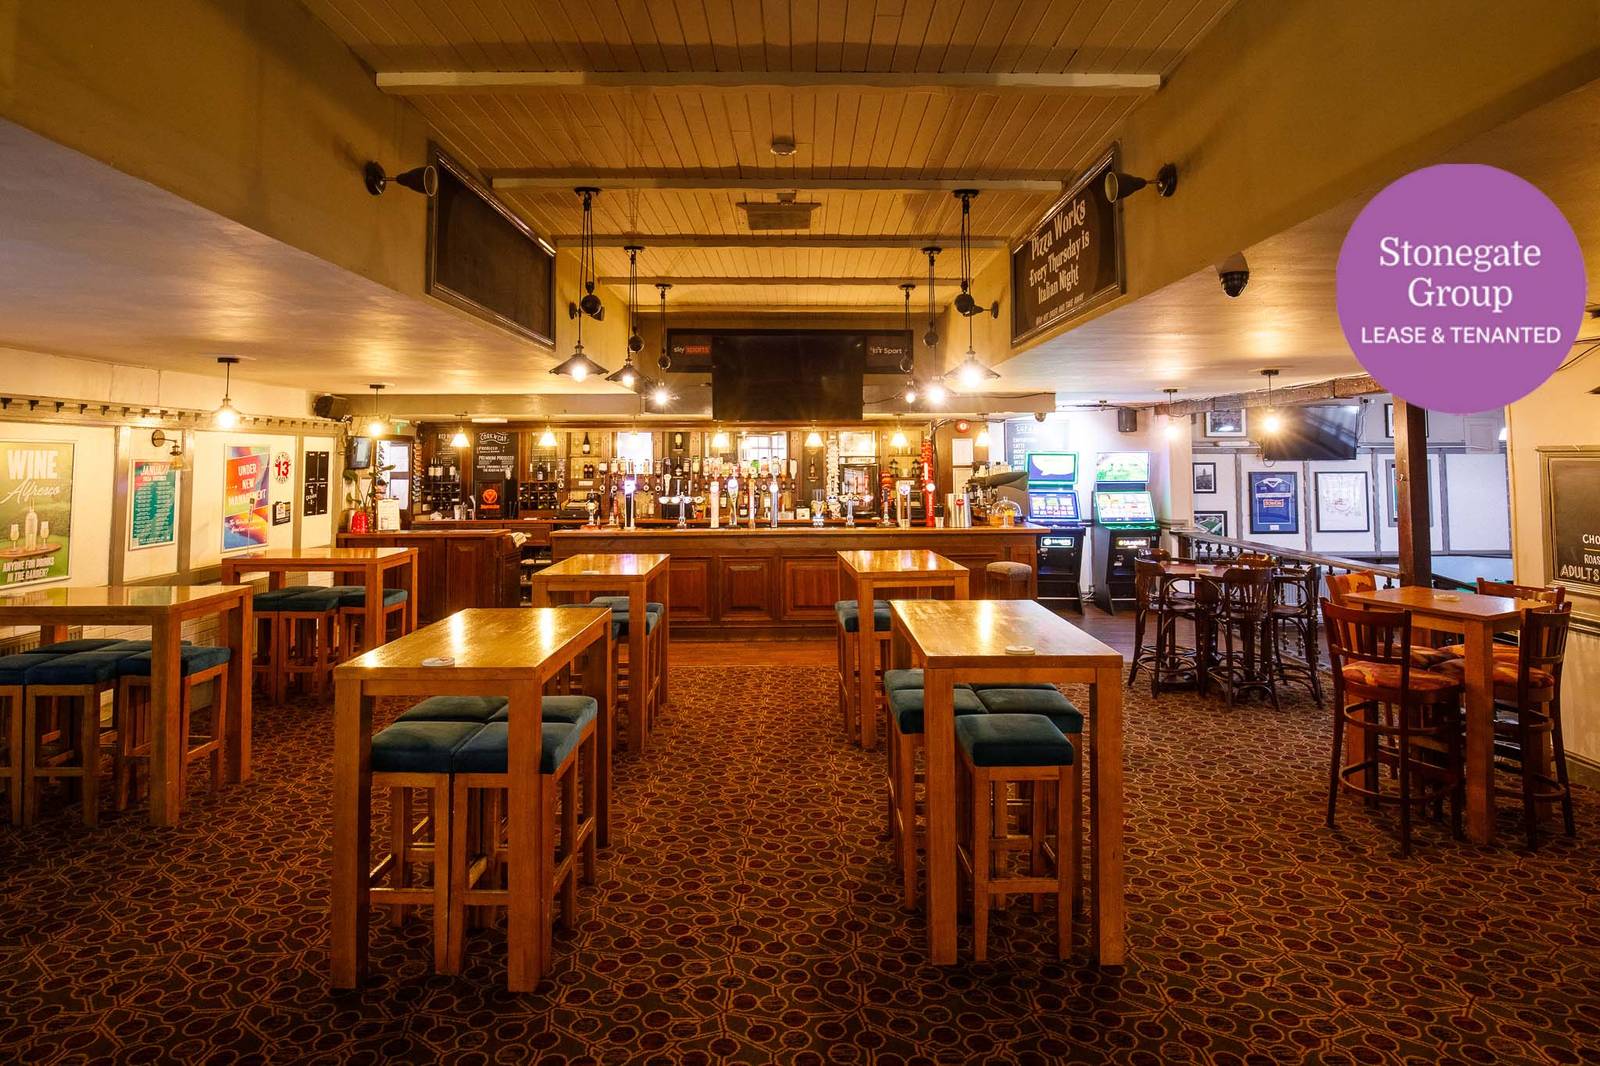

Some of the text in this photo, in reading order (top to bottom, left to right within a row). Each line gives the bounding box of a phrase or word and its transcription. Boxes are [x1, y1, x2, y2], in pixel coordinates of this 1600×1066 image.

[1031, 200, 1086, 261] Pizza Works
[1029, 229, 1090, 287] Every Thursday is
[1038, 263, 1079, 304] Italian Night
[884, 347, 902, 355] Sport
[7, 448, 59, 480] WINE
[238, 463, 257, 477] UNDER
[275, 461, 290, 477] 13
[0, 480, 61, 504] Alfresco
[242, 478, 255, 490] NEW
[228, 489, 267, 505] MANAGEMENT
[3, 560, 25, 572] ANYONE
[25, 559, 36, 569] FOR
[1560, 564, 1600, 582] ADULTS
[7, 572, 14, 583] IN
[15, 571, 25, 581] THE
